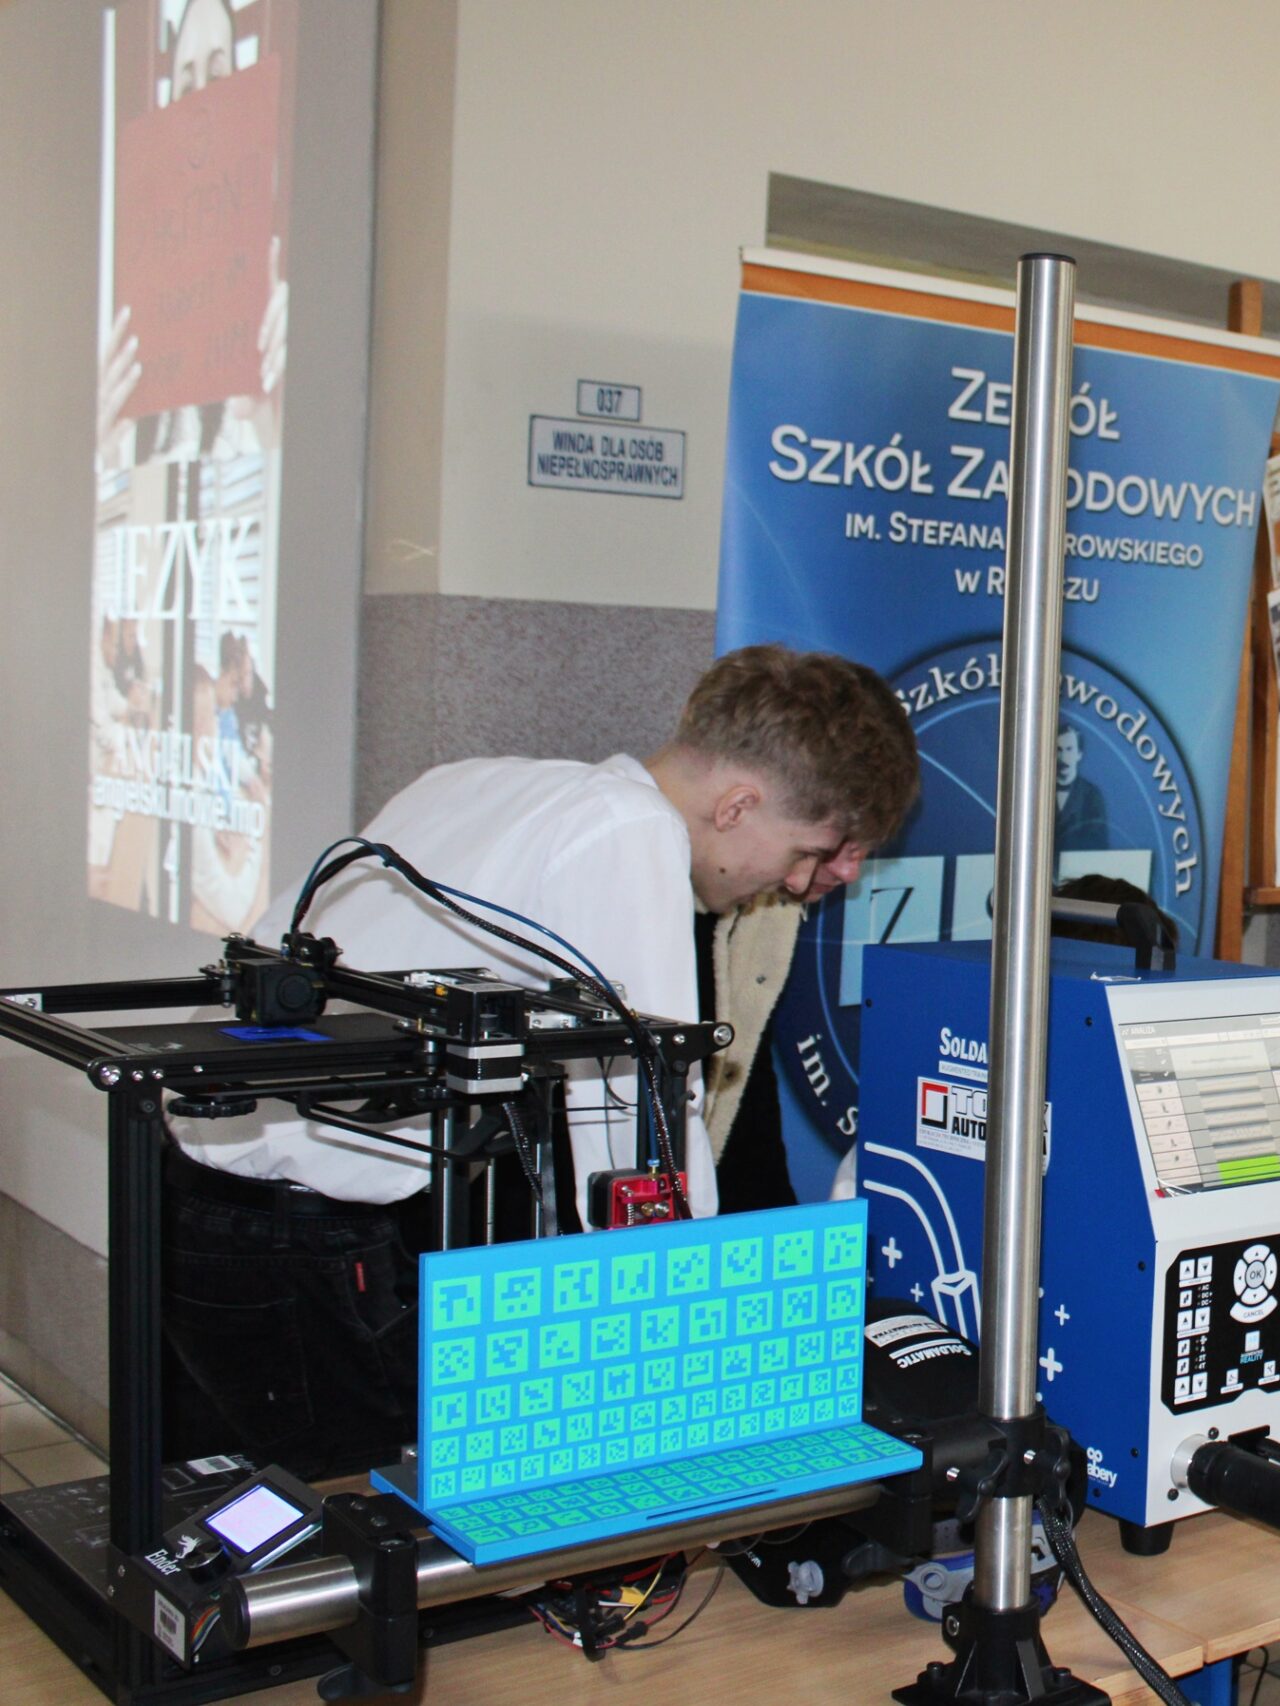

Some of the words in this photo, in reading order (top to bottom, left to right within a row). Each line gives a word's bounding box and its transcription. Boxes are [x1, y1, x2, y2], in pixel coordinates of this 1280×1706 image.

[597, 388, 622, 413] 037
[948, 367, 1120, 440] ZEÓŁ
[553, 431, 594, 455] WINDA
[601, 436, 625, 458] DLA
[629, 437, 664, 462] OSÓB
[537, 453, 678, 487] NIEPEŁNOSPRAWNYCH
[769, 424, 933, 493] SZKÓŁ
[947, 445, 1255, 526] ZAODOWYCH
[1060, 673, 1198, 898] wodowych
[939, 1027, 989, 1064] SOLDA
[1250, 1270, 1262, 1280] OK
[1243, 1309, 1264, 1319] CANCEL
[896, 1343, 973, 1369] SOLDAMATIC
[1087, 1462, 1118, 1488] abery
[144, 1548, 182, 1576] Ender
